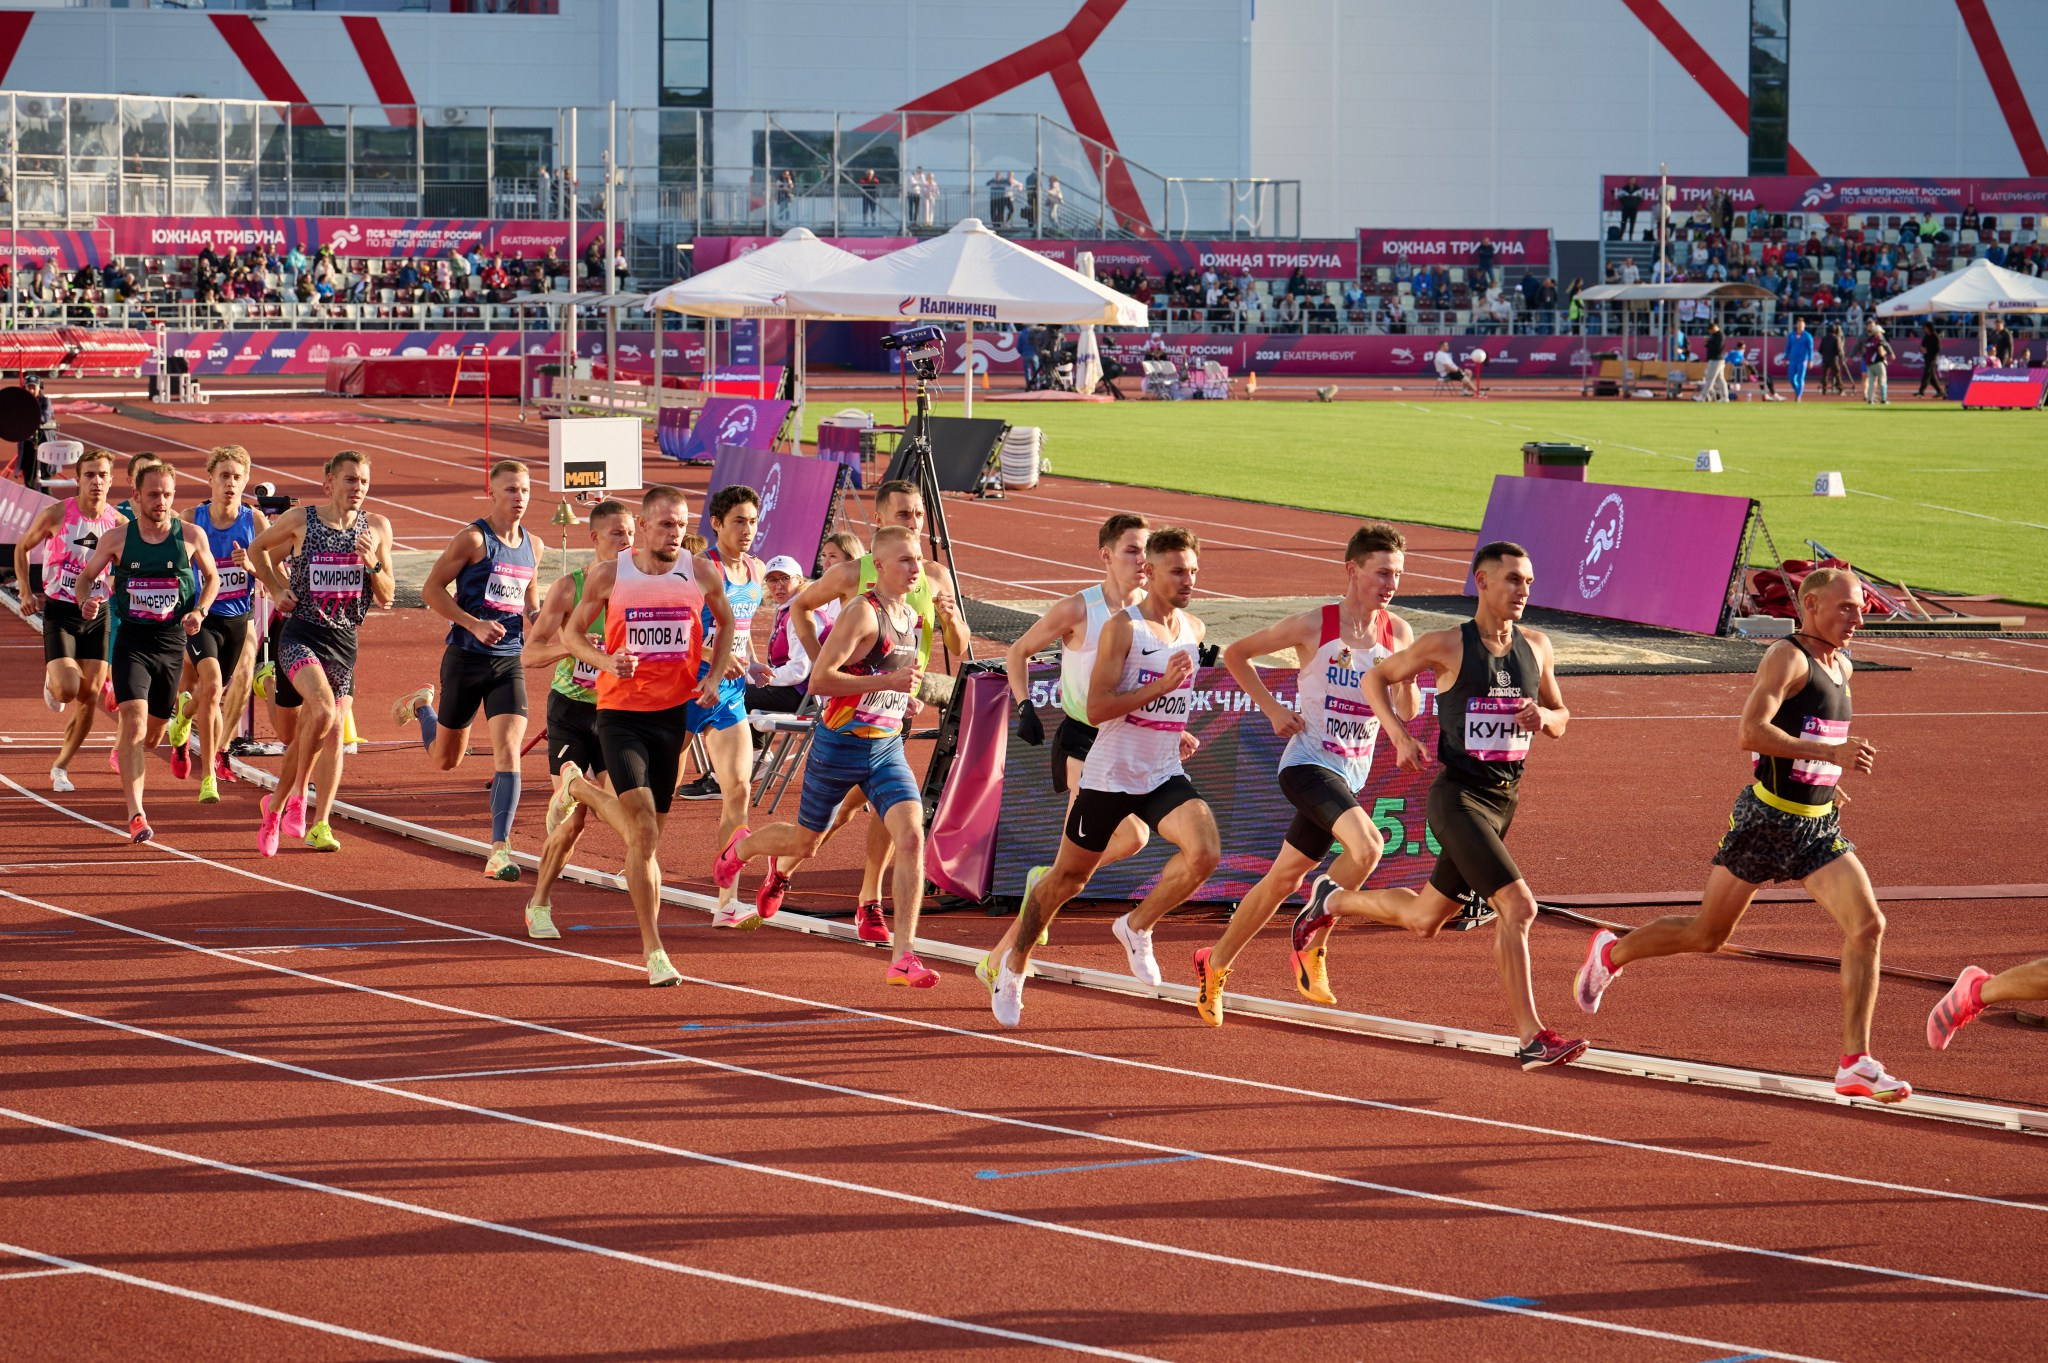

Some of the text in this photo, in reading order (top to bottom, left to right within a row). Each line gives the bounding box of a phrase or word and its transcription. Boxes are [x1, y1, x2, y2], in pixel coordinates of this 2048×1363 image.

[1862, 187, 1920, 196] ЧЕМПИОНАТ
[1922, 188, 1961, 197] РОССИИ
[152, 229, 286, 245] ЮЖНАЯ ТРИБУНА
[387, 229, 442, 240] ЧЕМПИОНАТ
[443, 231, 482, 240] РОССИИ
[501, 235, 566, 246] ЕКАТЕРИНБУРГ
[1383, 241, 1525, 255] ЮЖНАЯ ТРИУНА
[1200, 253, 1342, 268] ЮЖНАЯ ТРИБУНА
[1190, 346, 1233, 355] РОССИИ
[1255, 351, 1357, 361] 2024 ЕКАТЕРИНБУРГ
[1696, 456, 1710, 468] 50
[1815, 478, 1829, 492] 60
[313, 569, 361, 586] СМИРНОВ
[629, 627, 672, 646] ПОПОВ
[674, 627, 687, 645] А.
[1480, 702, 1499, 711] ПСБ
